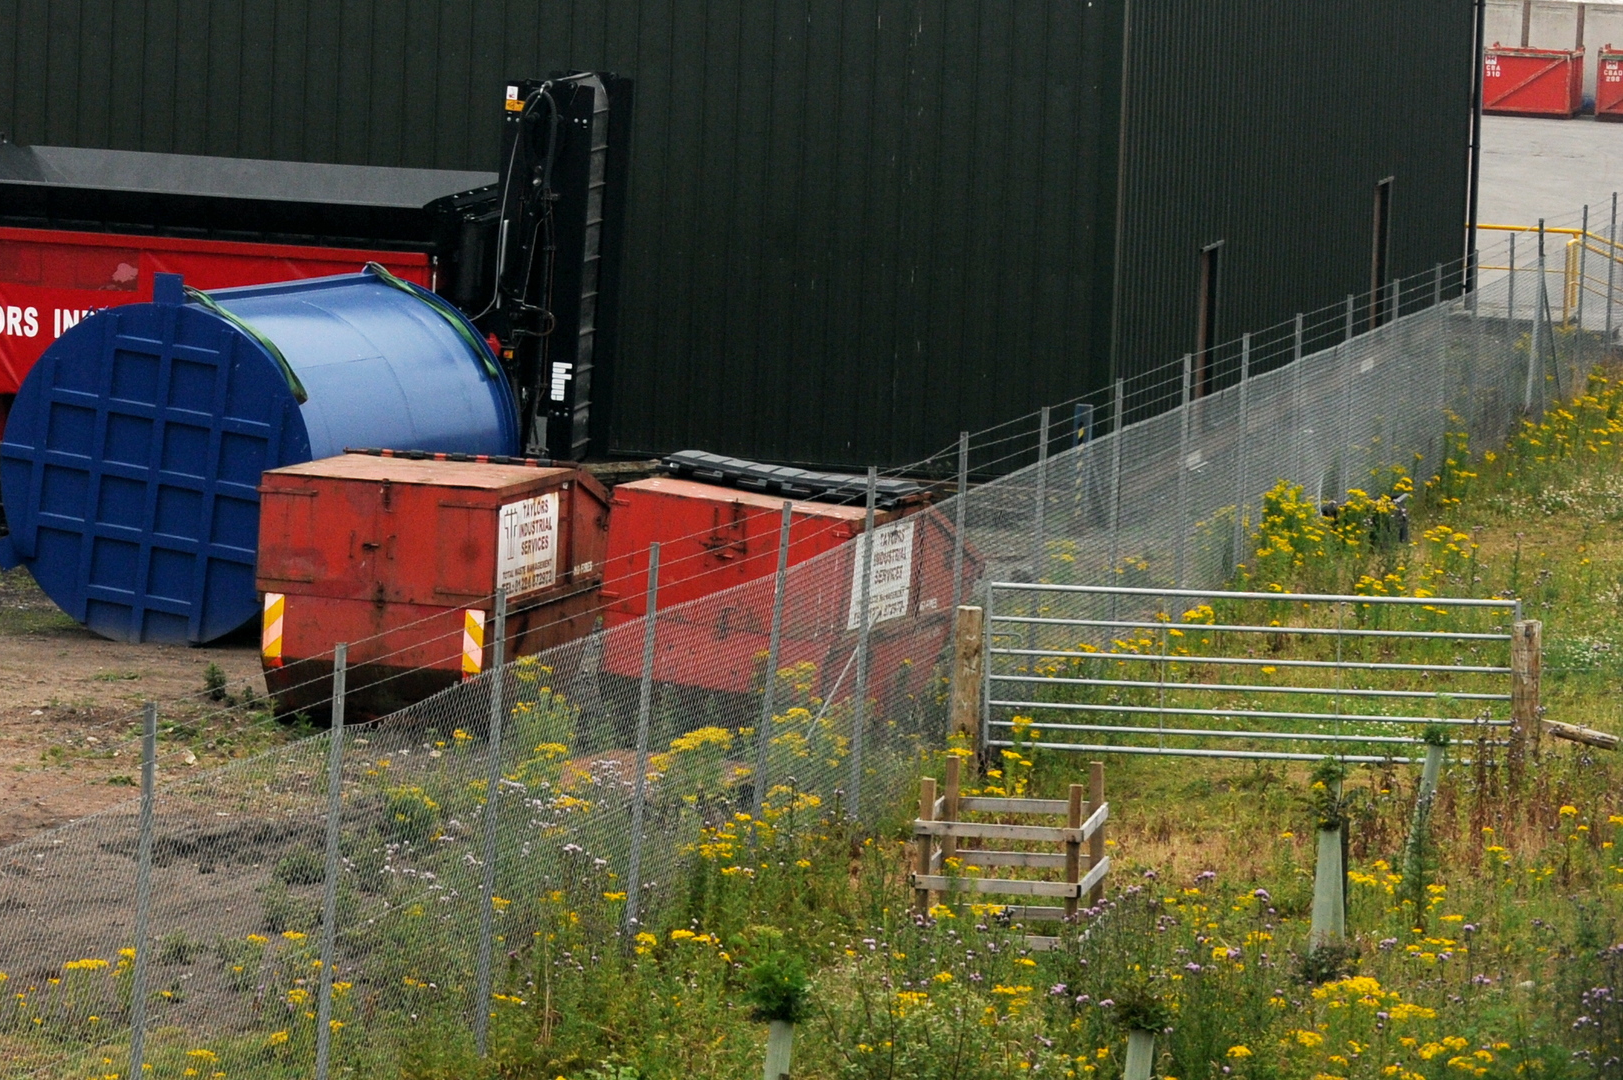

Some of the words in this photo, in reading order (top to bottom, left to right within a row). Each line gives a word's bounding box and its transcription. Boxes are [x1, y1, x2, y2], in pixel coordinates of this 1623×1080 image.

[551, 362, 572, 401] blue
[522, 499, 549, 519] TAYLORS
[519, 516, 552, 538] INDUSTRIAL
[521, 535, 549, 556] SERVICES
